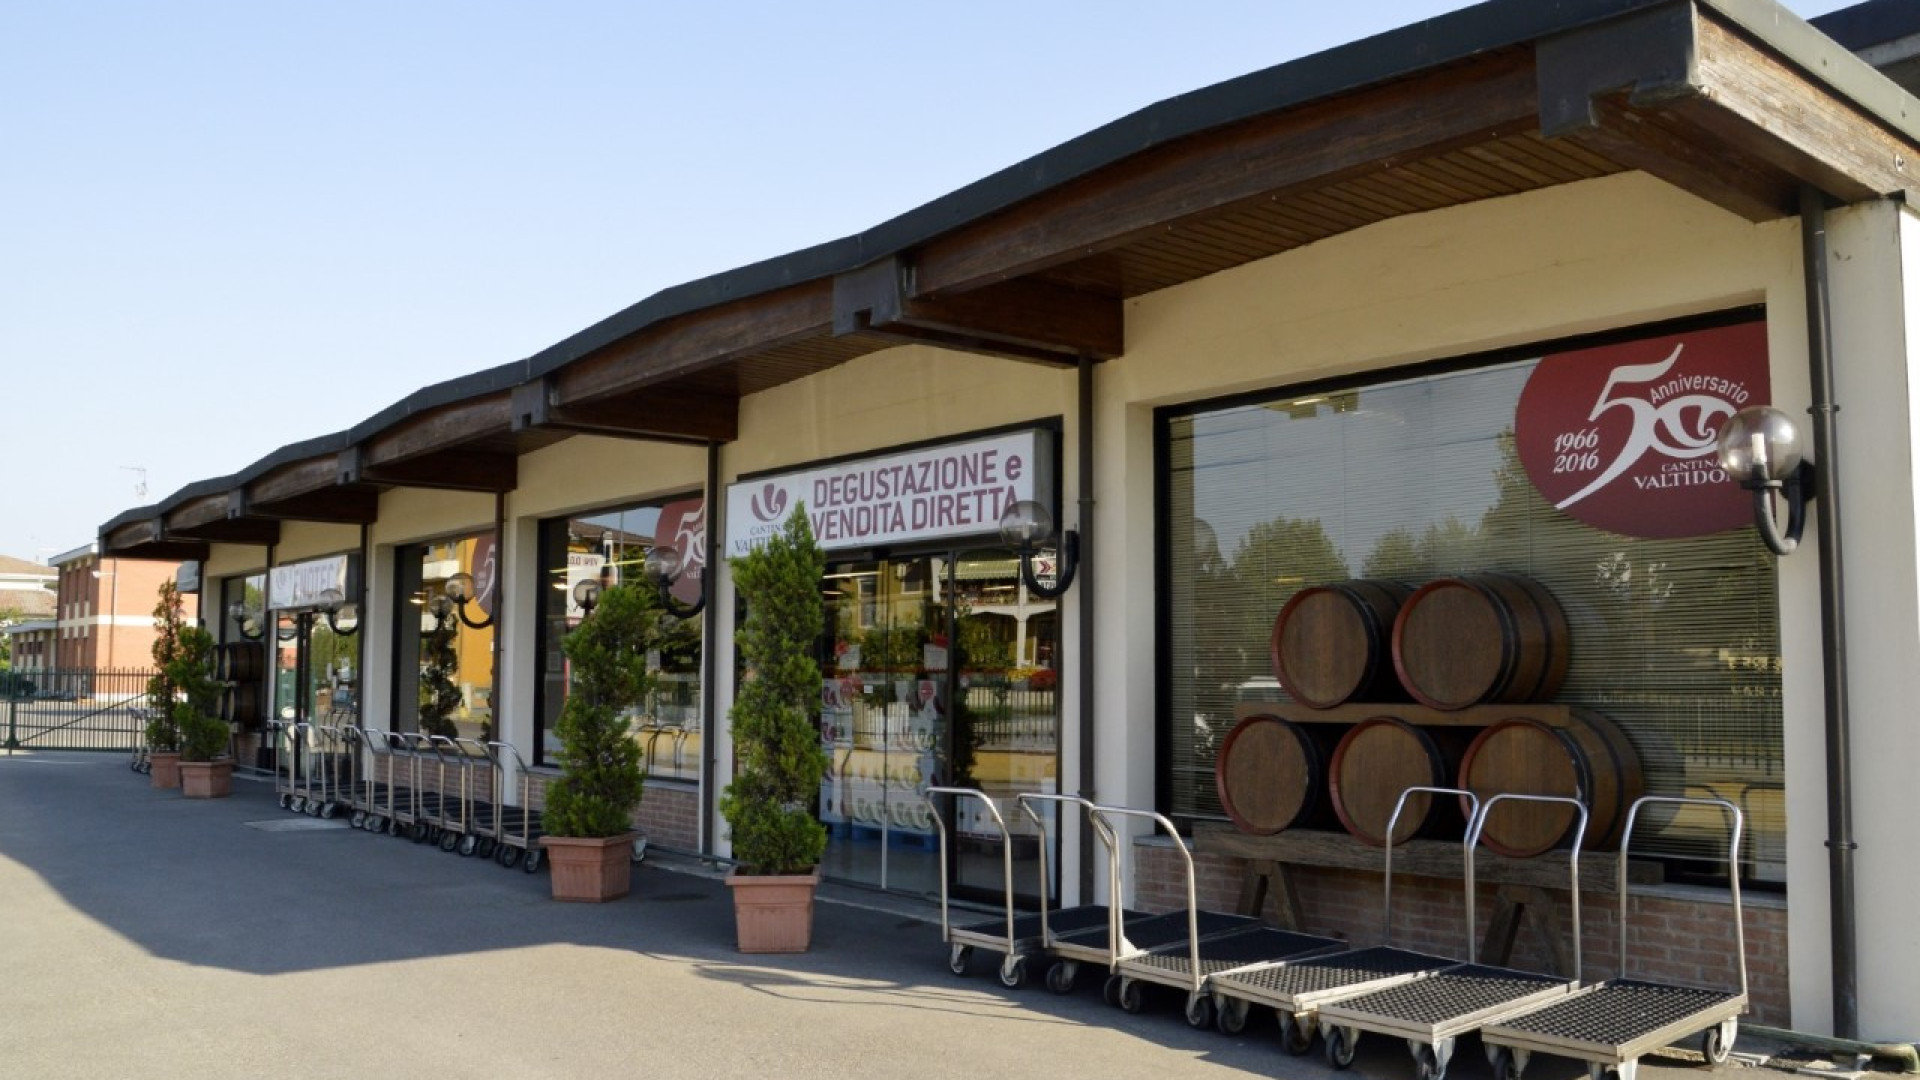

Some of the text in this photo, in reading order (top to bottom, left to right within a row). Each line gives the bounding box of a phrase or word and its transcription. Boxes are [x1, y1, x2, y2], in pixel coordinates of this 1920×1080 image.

[1650, 373, 1750, 404] Anniversario
[1553, 427, 1599, 452] 1966
[1554, 452, 1599, 473] 2016
[813, 449, 1022, 509] DEGUSTAZIONE e
[1633, 470, 1731, 490] VALTIDO
[811, 485, 1021, 541] VENDITA DIRETTA
